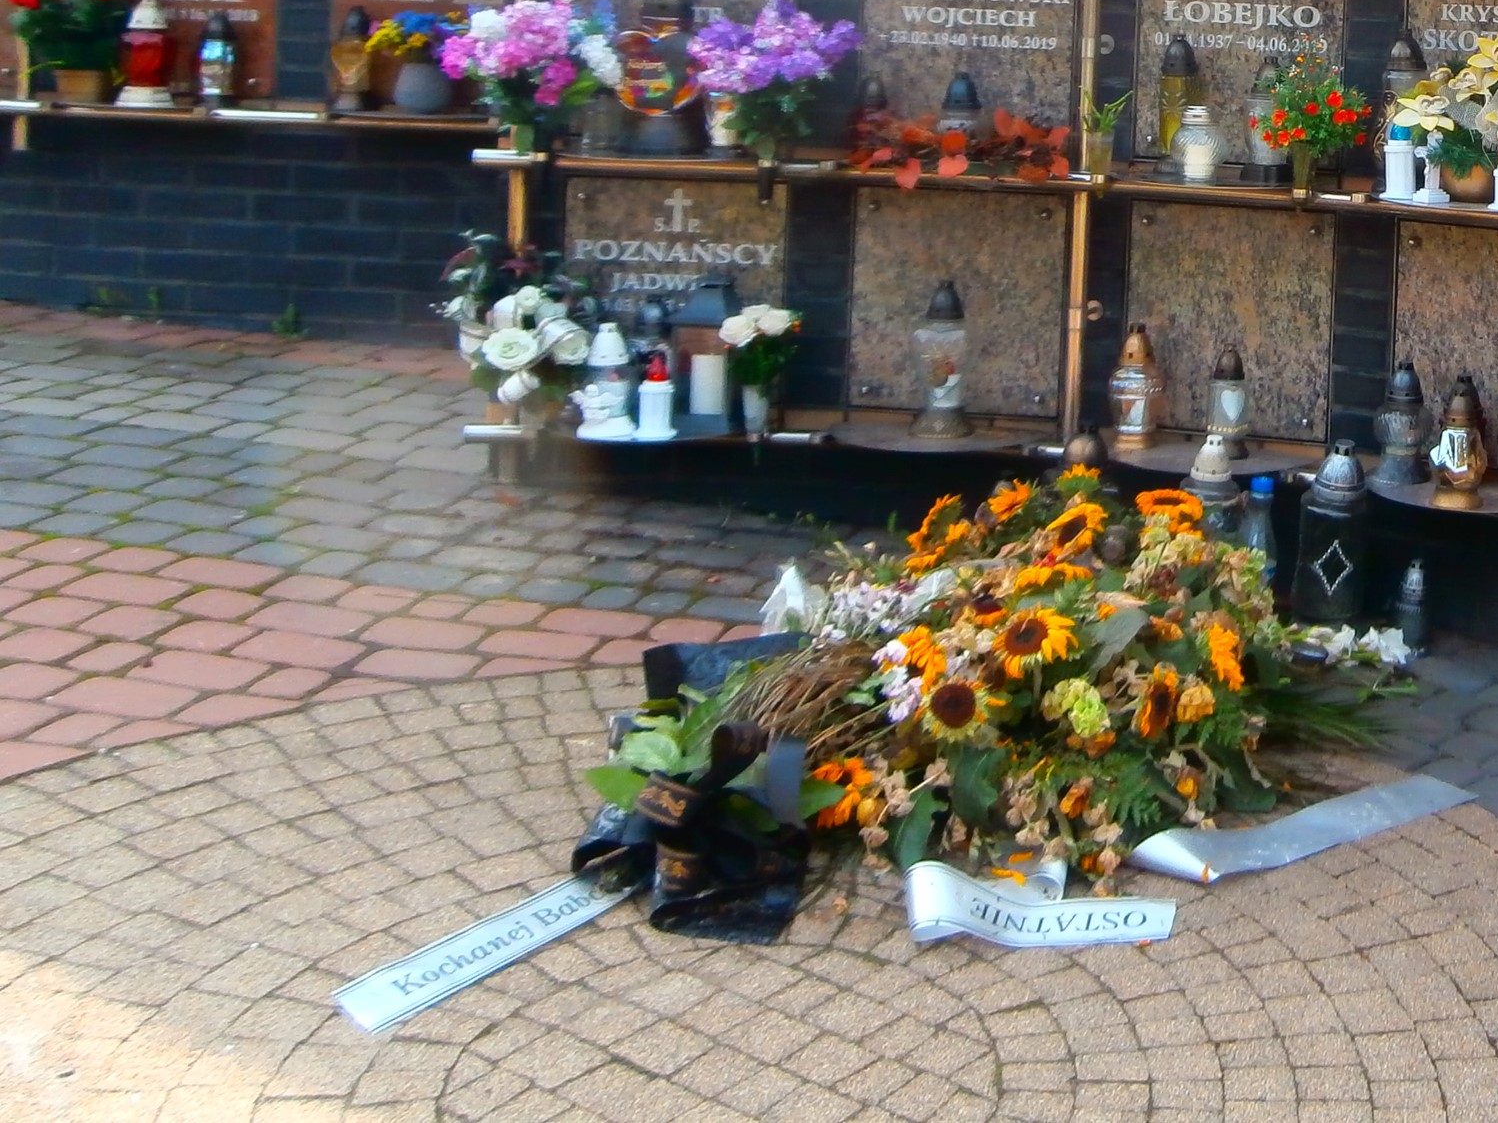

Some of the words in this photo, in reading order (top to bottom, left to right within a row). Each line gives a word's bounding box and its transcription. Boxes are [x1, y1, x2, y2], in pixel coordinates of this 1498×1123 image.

[901, 6, 1038, 28] WOJCIECH
[1163, 0, 1322, 31] ŁOBEJKO
[574, 239, 778, 266] POZNAŃSCY
[970, 896, 1148, 934] OSTATNIE
[391, 919, 535, 997] Kochanej
